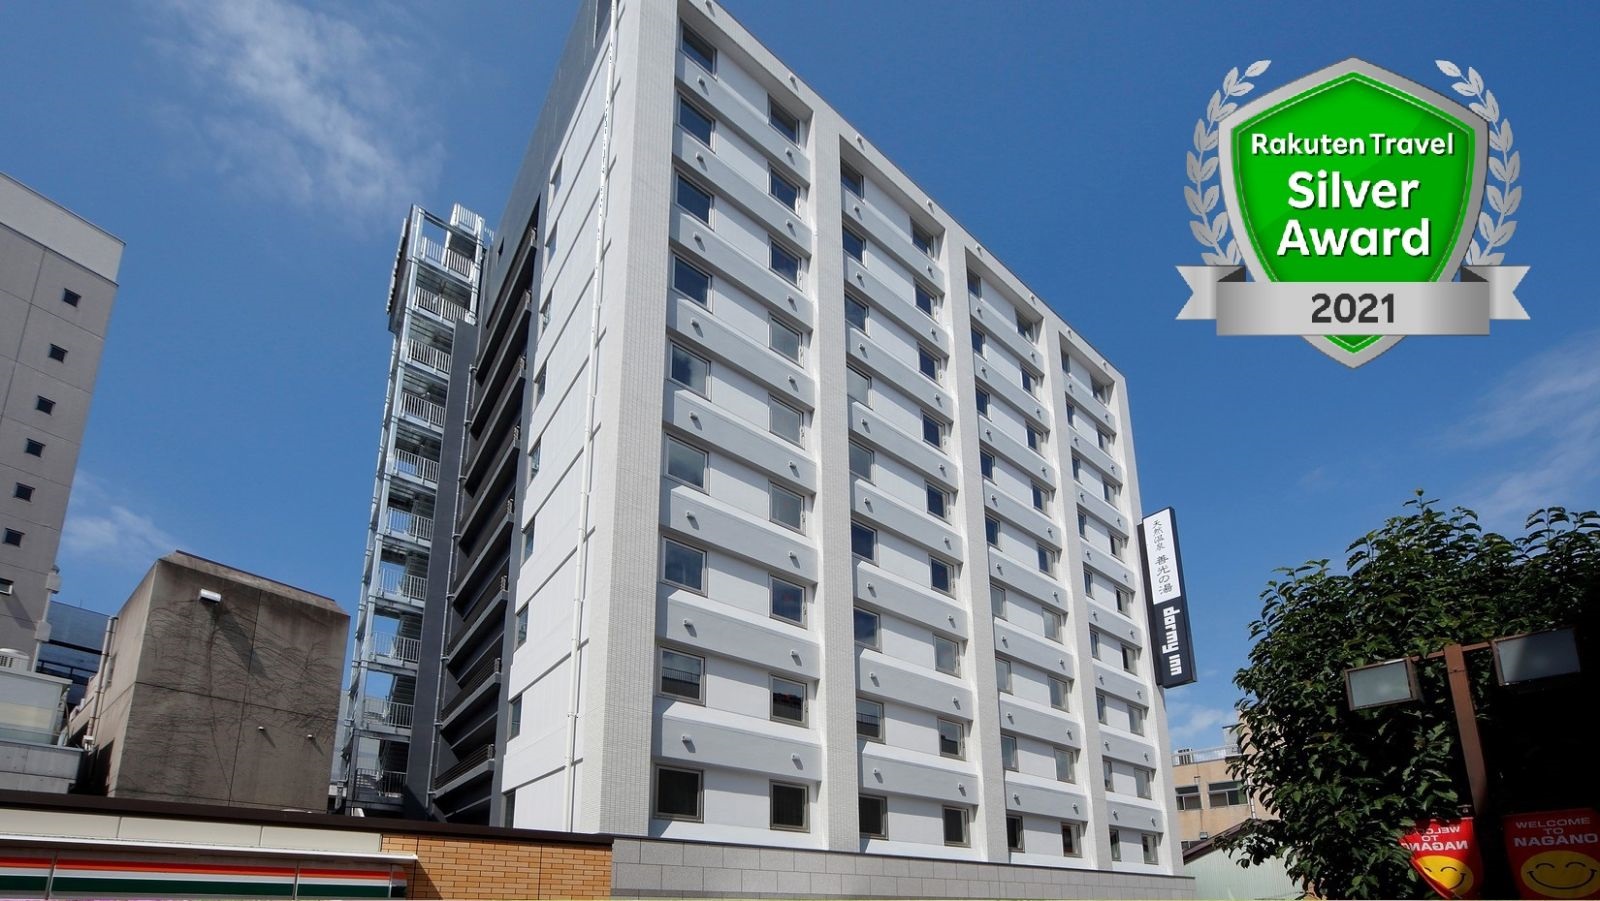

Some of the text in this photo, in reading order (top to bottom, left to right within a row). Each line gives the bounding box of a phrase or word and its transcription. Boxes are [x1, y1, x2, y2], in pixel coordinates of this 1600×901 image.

[1153, 519, 1173, 595] 天然温泉 善光の湯
[1162, 606, 1180, 654] dormy
[1515, 817, 1591, 829] WELCOME
[1543, 827, 1564, 836] TO
[1513, 833, 1598, 848] NAGANO
